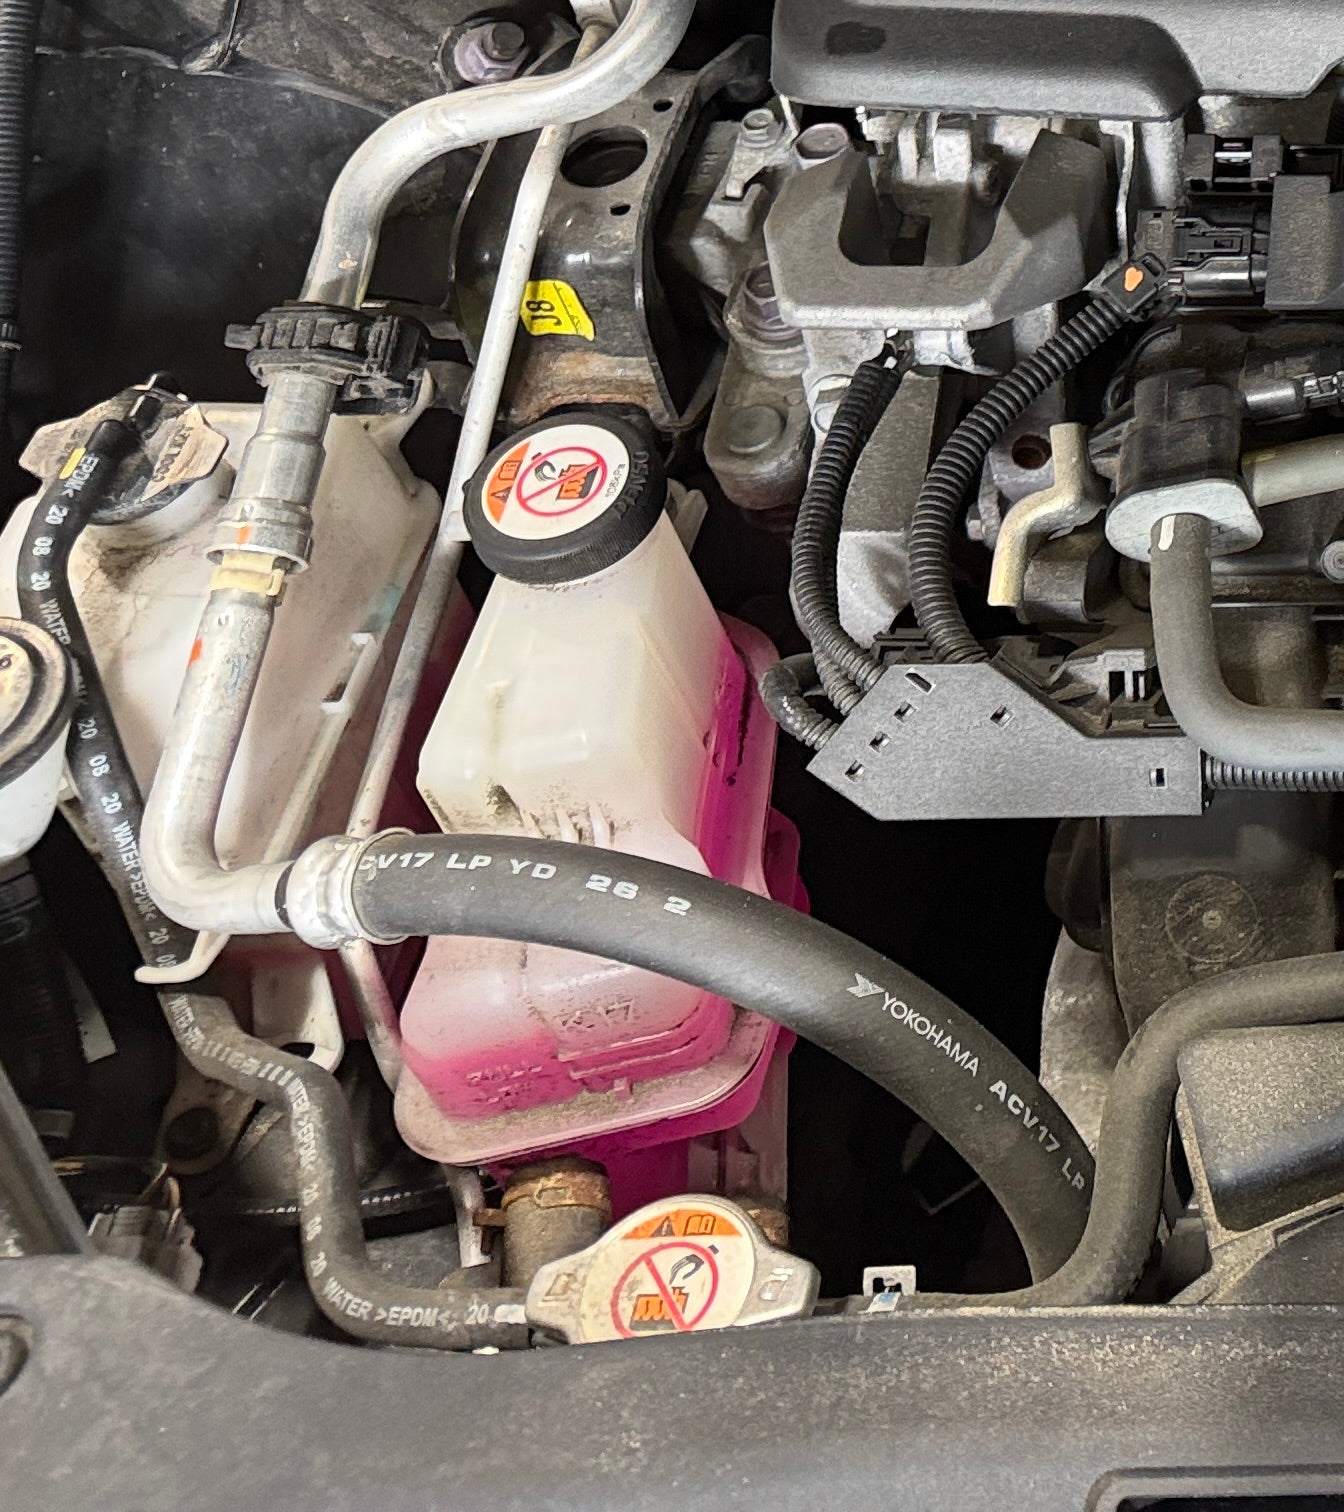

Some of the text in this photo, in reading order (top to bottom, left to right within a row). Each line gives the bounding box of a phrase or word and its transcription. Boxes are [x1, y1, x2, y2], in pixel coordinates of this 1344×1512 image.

[526, 299, 562, 327] J8
[45, 504, 69, 526] 20
[30, 571, 51, 592] 20
[100, 791, 124, 815] 20
[111, 819, 141, 872] WATER
[357, 851, 693, 917] CV17 LP YD 26 2
[149, 927, 170, 945] 20
[881, 991, 1087, 1191] YOKOHAMA ACV17 LP
[321, 1276, 374, 1322] WATER
[465, 1303, 489, 1325] 20
